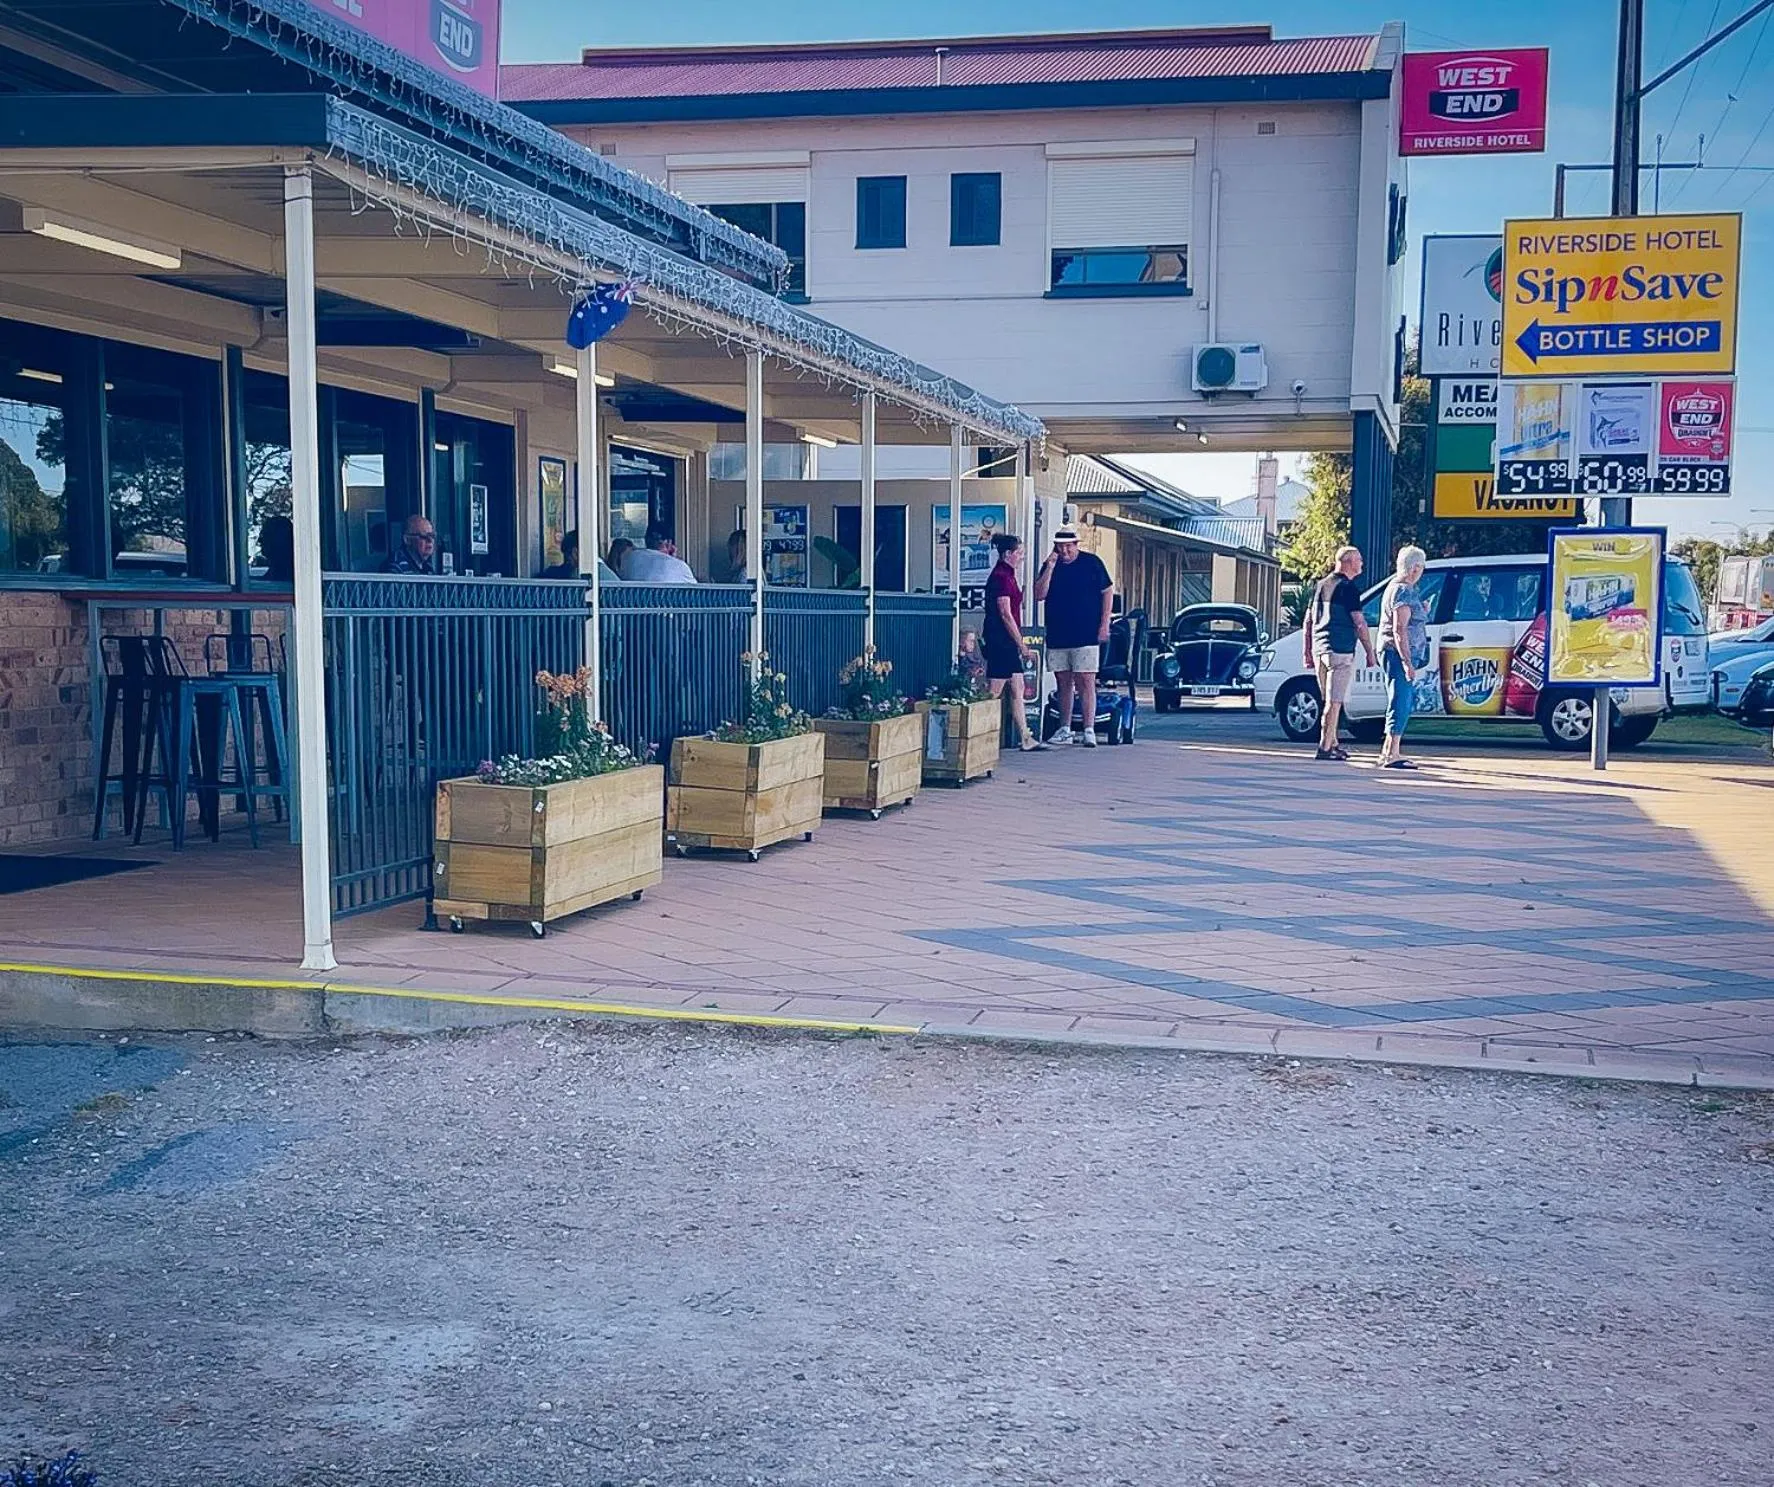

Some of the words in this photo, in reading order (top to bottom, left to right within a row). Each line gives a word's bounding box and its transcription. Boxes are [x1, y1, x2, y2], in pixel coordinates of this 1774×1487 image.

[439, 11, 473, 58] END
[1437, 66, 1513, 87] WEST
[1445, 94, 1503, 114] END
[1414, 135, 1484, 149] RIVERSIDE
[1487, 133, 1531, 147] HOTEL
[1518, 232, 1636, 255] RIVERSIDE
[1645, 230, 1723, 250] HOTEL
[1515, 265, 1724, 314] SipnSave
[1538, 329, 1632, 351] BOTTLE
[1642, 326, 1711, 348] SHOP
[1675, 399, 1719, 411] WEST
[1679, 413, 1713, 425] END
[1592, 542, 1616, 551] WIN
[1452, 659, 1499, 682] HAHN
